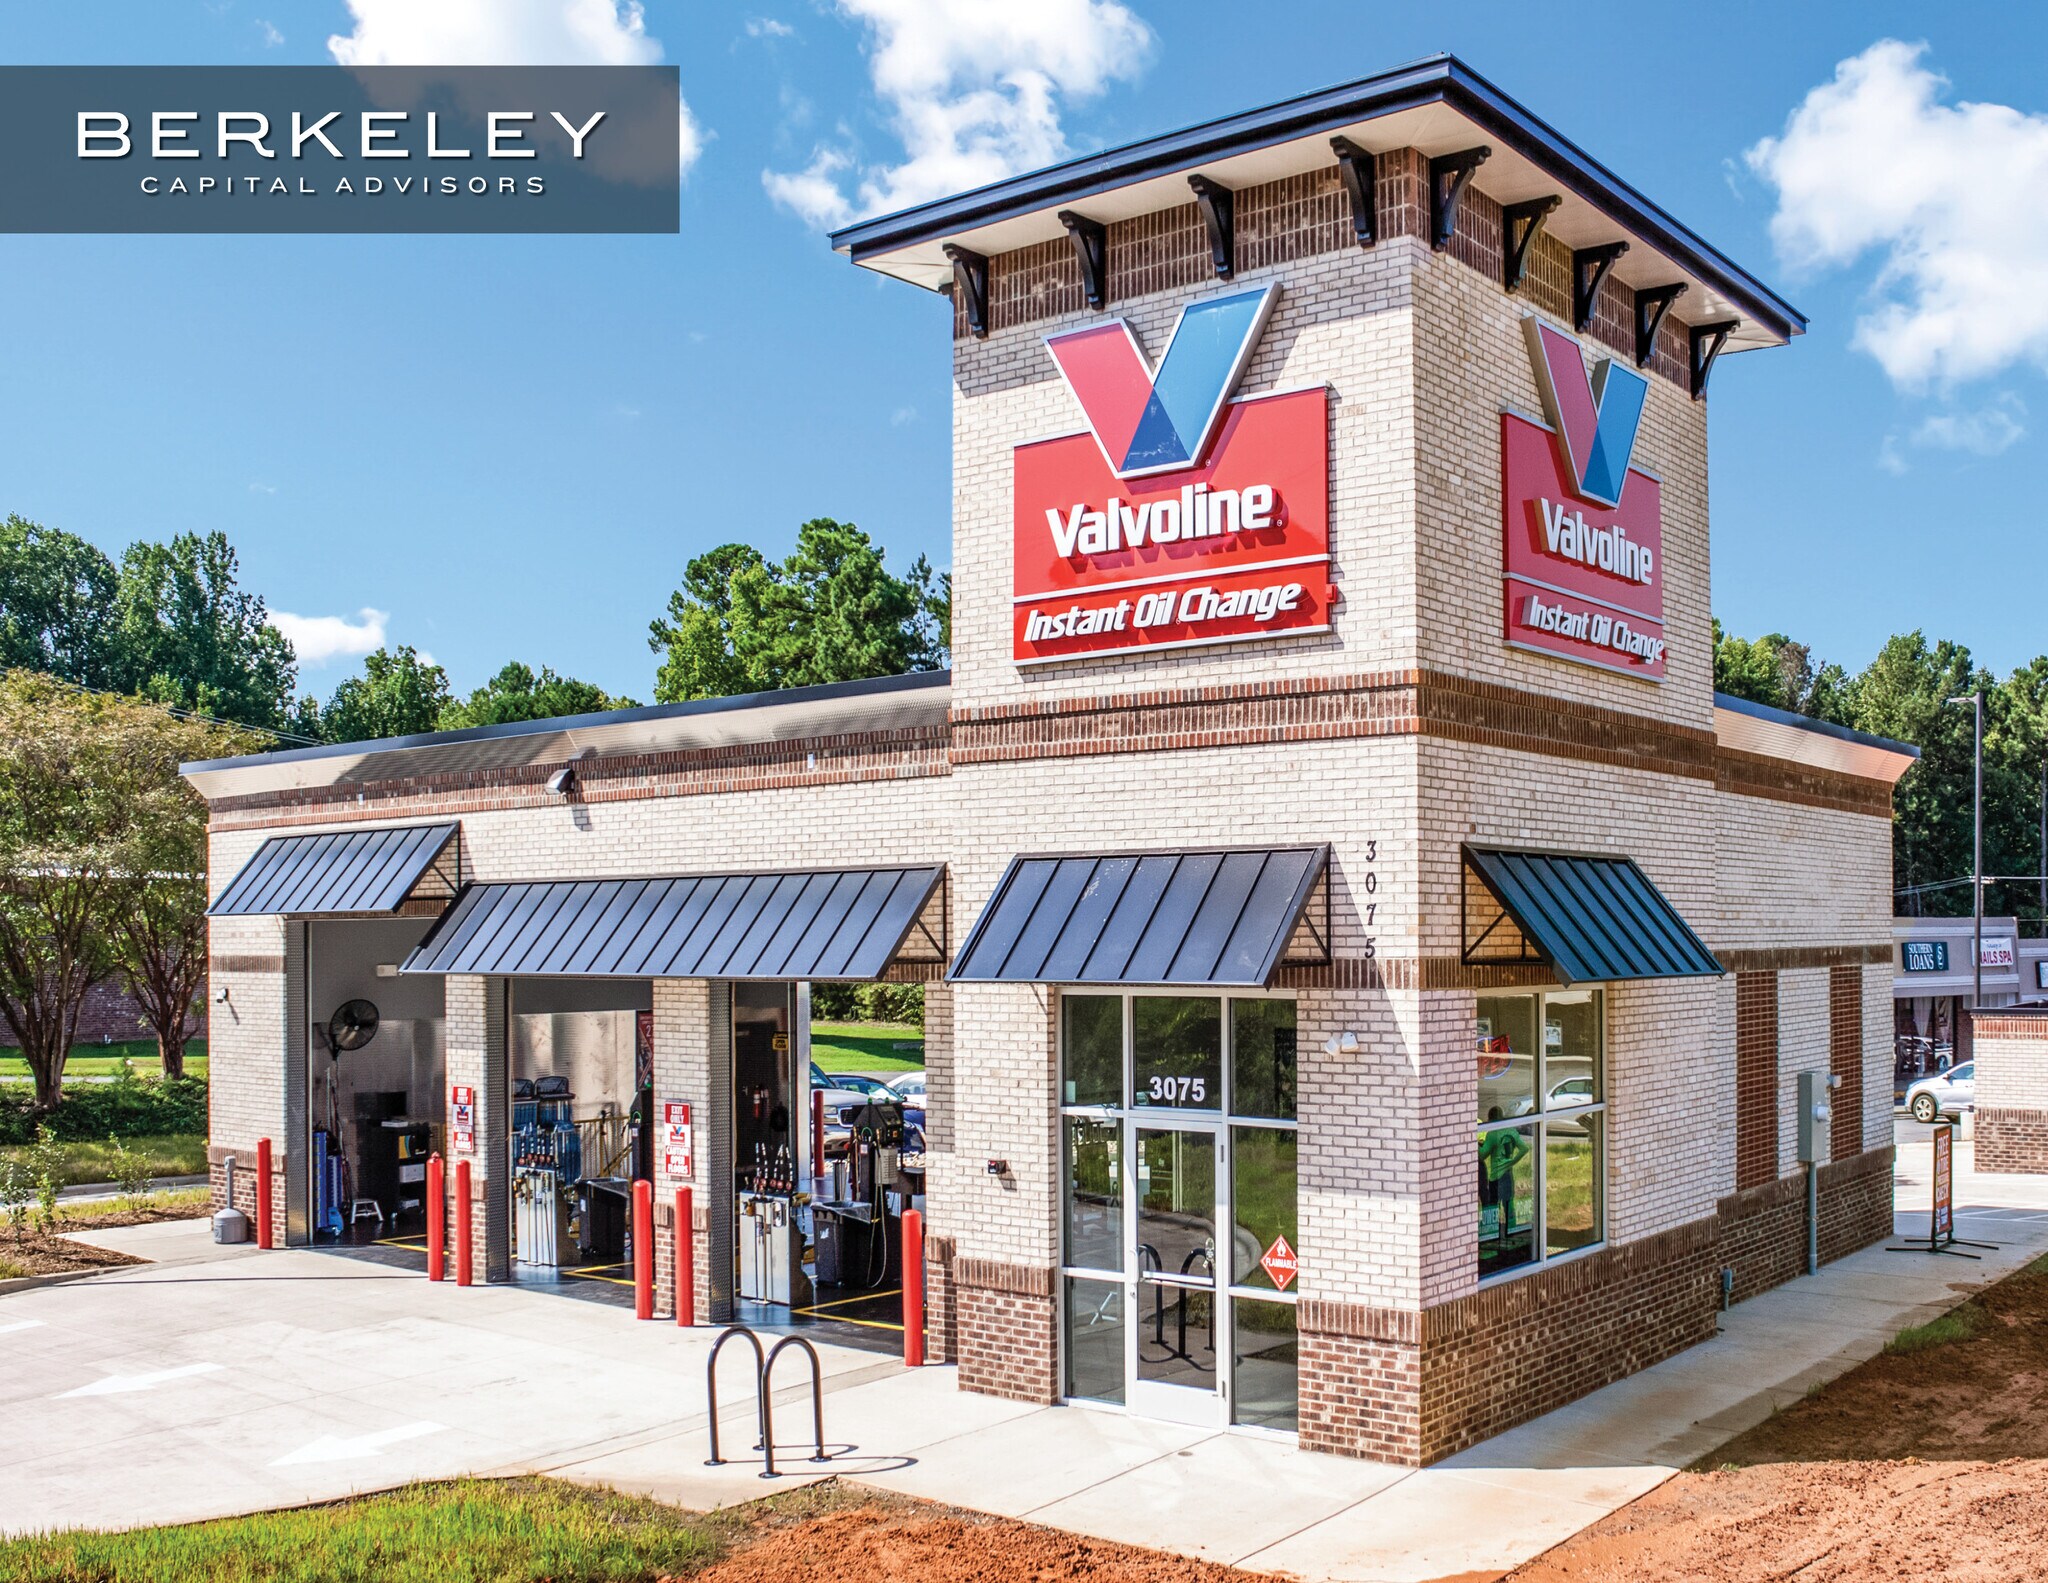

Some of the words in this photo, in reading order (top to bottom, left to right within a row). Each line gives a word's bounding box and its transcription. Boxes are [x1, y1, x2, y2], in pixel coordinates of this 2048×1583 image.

[1045, 482, 1274, 558] Valvoline
[1540, 497, 1653, 586] Valvoline
[1023, 598, 1131, 642] Instant
[1132, 590, 1178, 628] Oil
[1178, 582, 1302, 623] Change
[1528, 595, 1589, 641] Instant
[1590, 613, 1613, 647] Oil
[1612, 620, 1665, 665] Change
[1908, 943, 1933, 954] SOUTHERN
[1980, 950, 1998, 965] AILS
[1998, 950, 2013, 964] SPA
[1909, 954, 1935, 971] LOANS
[1149, 1075, 1206, 1102] 3075
[1265, 1257, 1297, 1270] FLAMMABLE
[1278, 1274, 1284, 1283] 3
